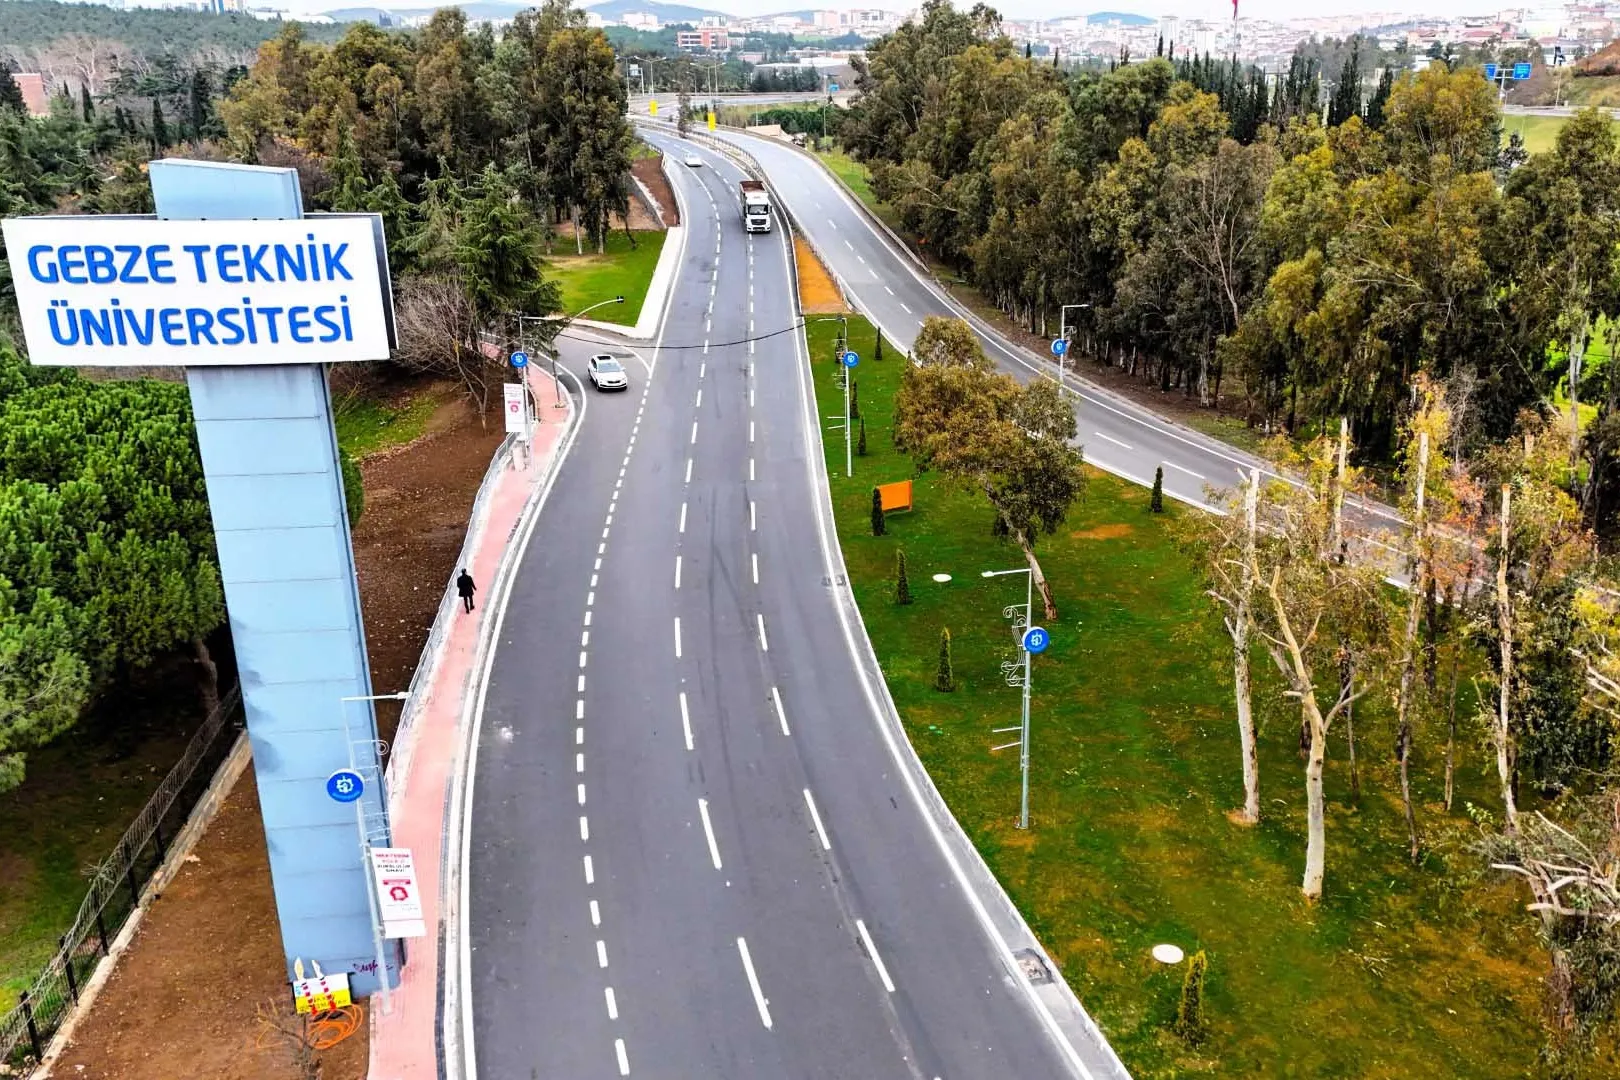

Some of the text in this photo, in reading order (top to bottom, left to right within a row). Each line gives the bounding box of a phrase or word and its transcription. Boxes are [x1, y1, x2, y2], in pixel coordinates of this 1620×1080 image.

[27, 232, 353, 284] GEBZE TEKNİK
[47, 294, 354, 347] ÜNİVERSİTESİ
